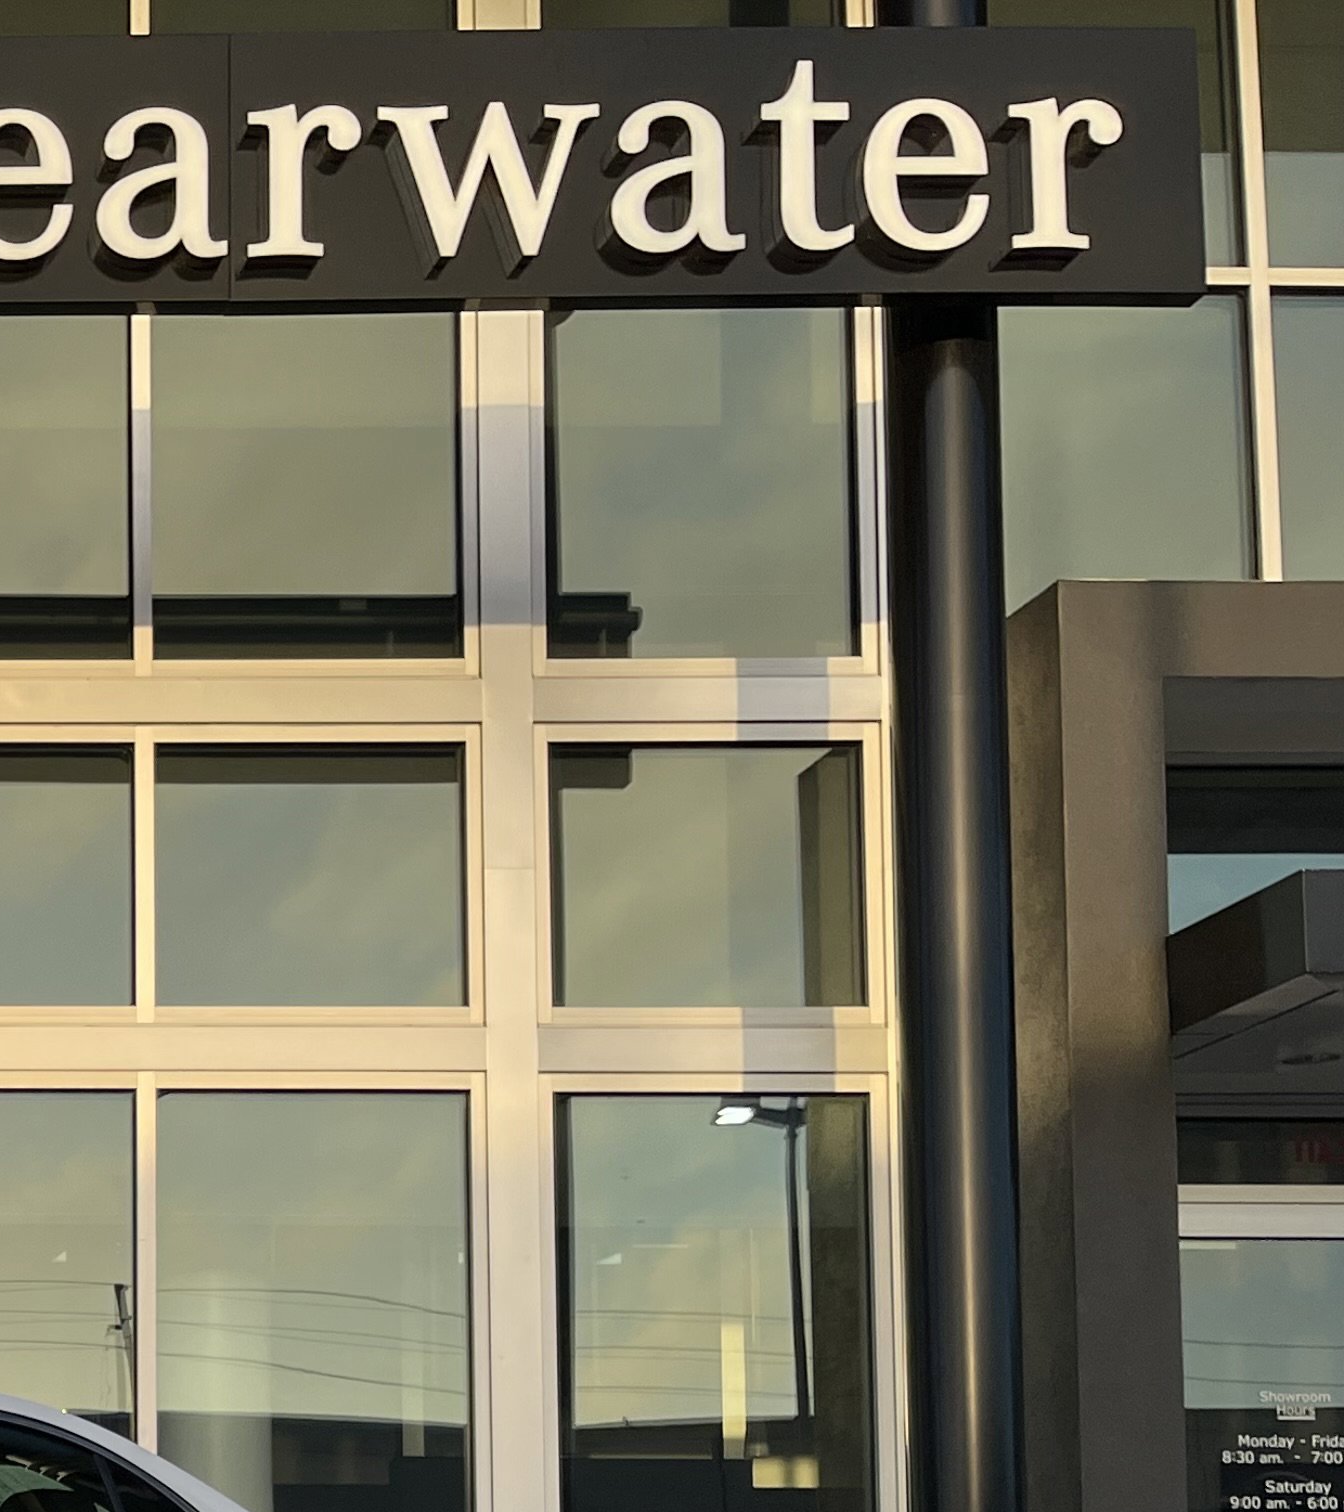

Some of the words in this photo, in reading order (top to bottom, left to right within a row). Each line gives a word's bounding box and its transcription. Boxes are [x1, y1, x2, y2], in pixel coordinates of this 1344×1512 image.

[1259, 1390, 1331, 1403] Showroom
[1276, 1404, 1316, 1420] Hours
[1237, 1434, 1295, 1450] Monday
[1222, 1450, 1255, 1464] 8:30
[1311, 1451, 1343, 1464] 7:00
[1264, 1480, 1332, 1496] Saturday
[1229, 1496, 1261, 1510] 9:00
[1307, 1497, 1339, 1510] 6:00
